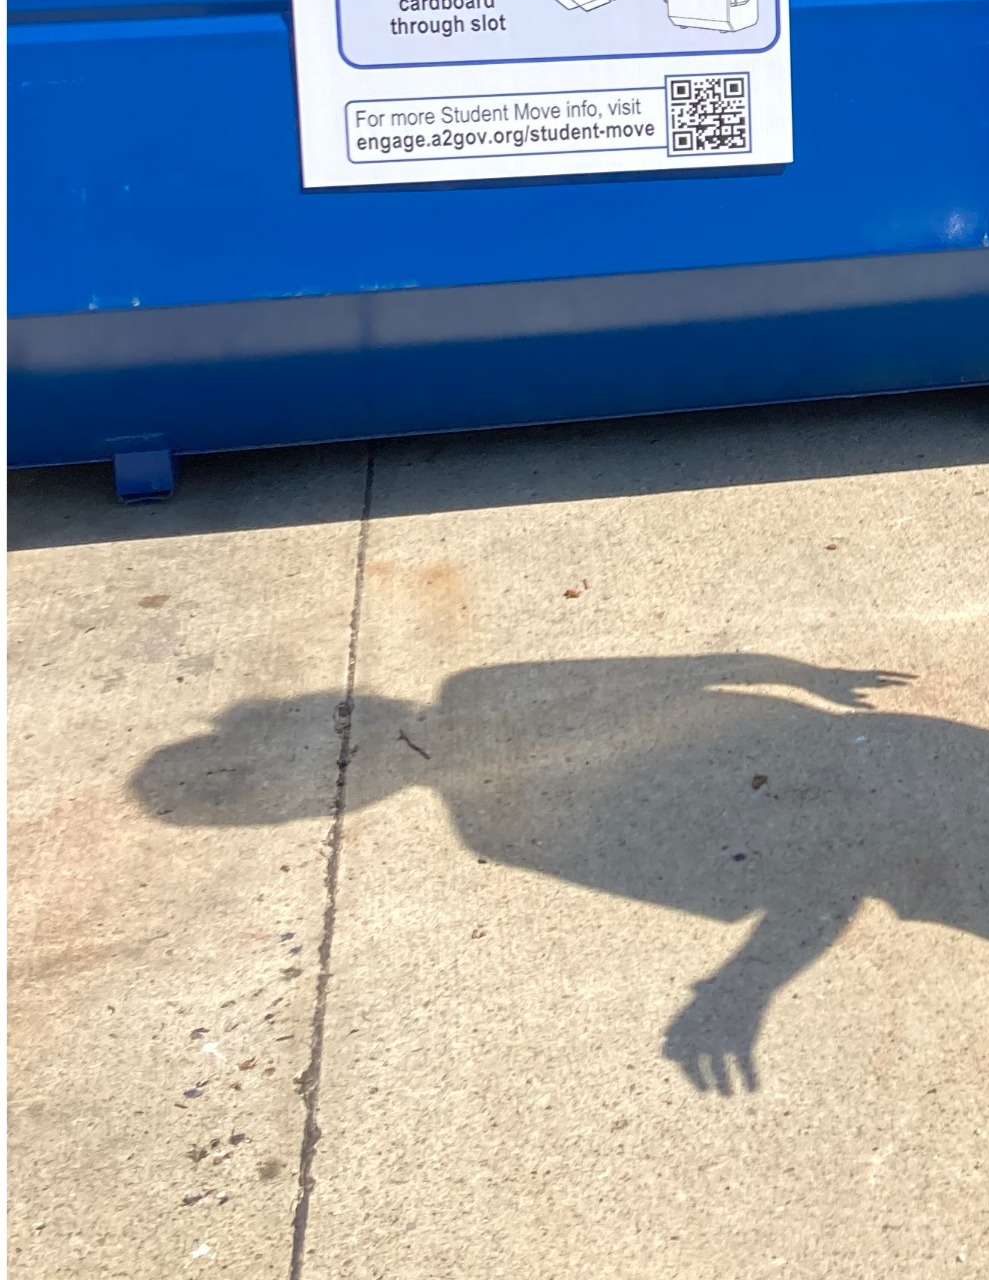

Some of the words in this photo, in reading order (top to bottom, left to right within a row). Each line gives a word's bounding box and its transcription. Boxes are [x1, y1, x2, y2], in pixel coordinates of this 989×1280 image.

[390, 15, 465, 37] through
[471, 14, 507, 33] slot
[355, 108, 386, 128] For
[391, 110, 435, 126] more
[440, 104, 510, 125] Student
[514, 100, 561, 121] Move
[565, 98, 602, 120] info,
[607, 97, 642, 117] visit
[356, 121, 655, 153] engage.a2gov.org/student-move
